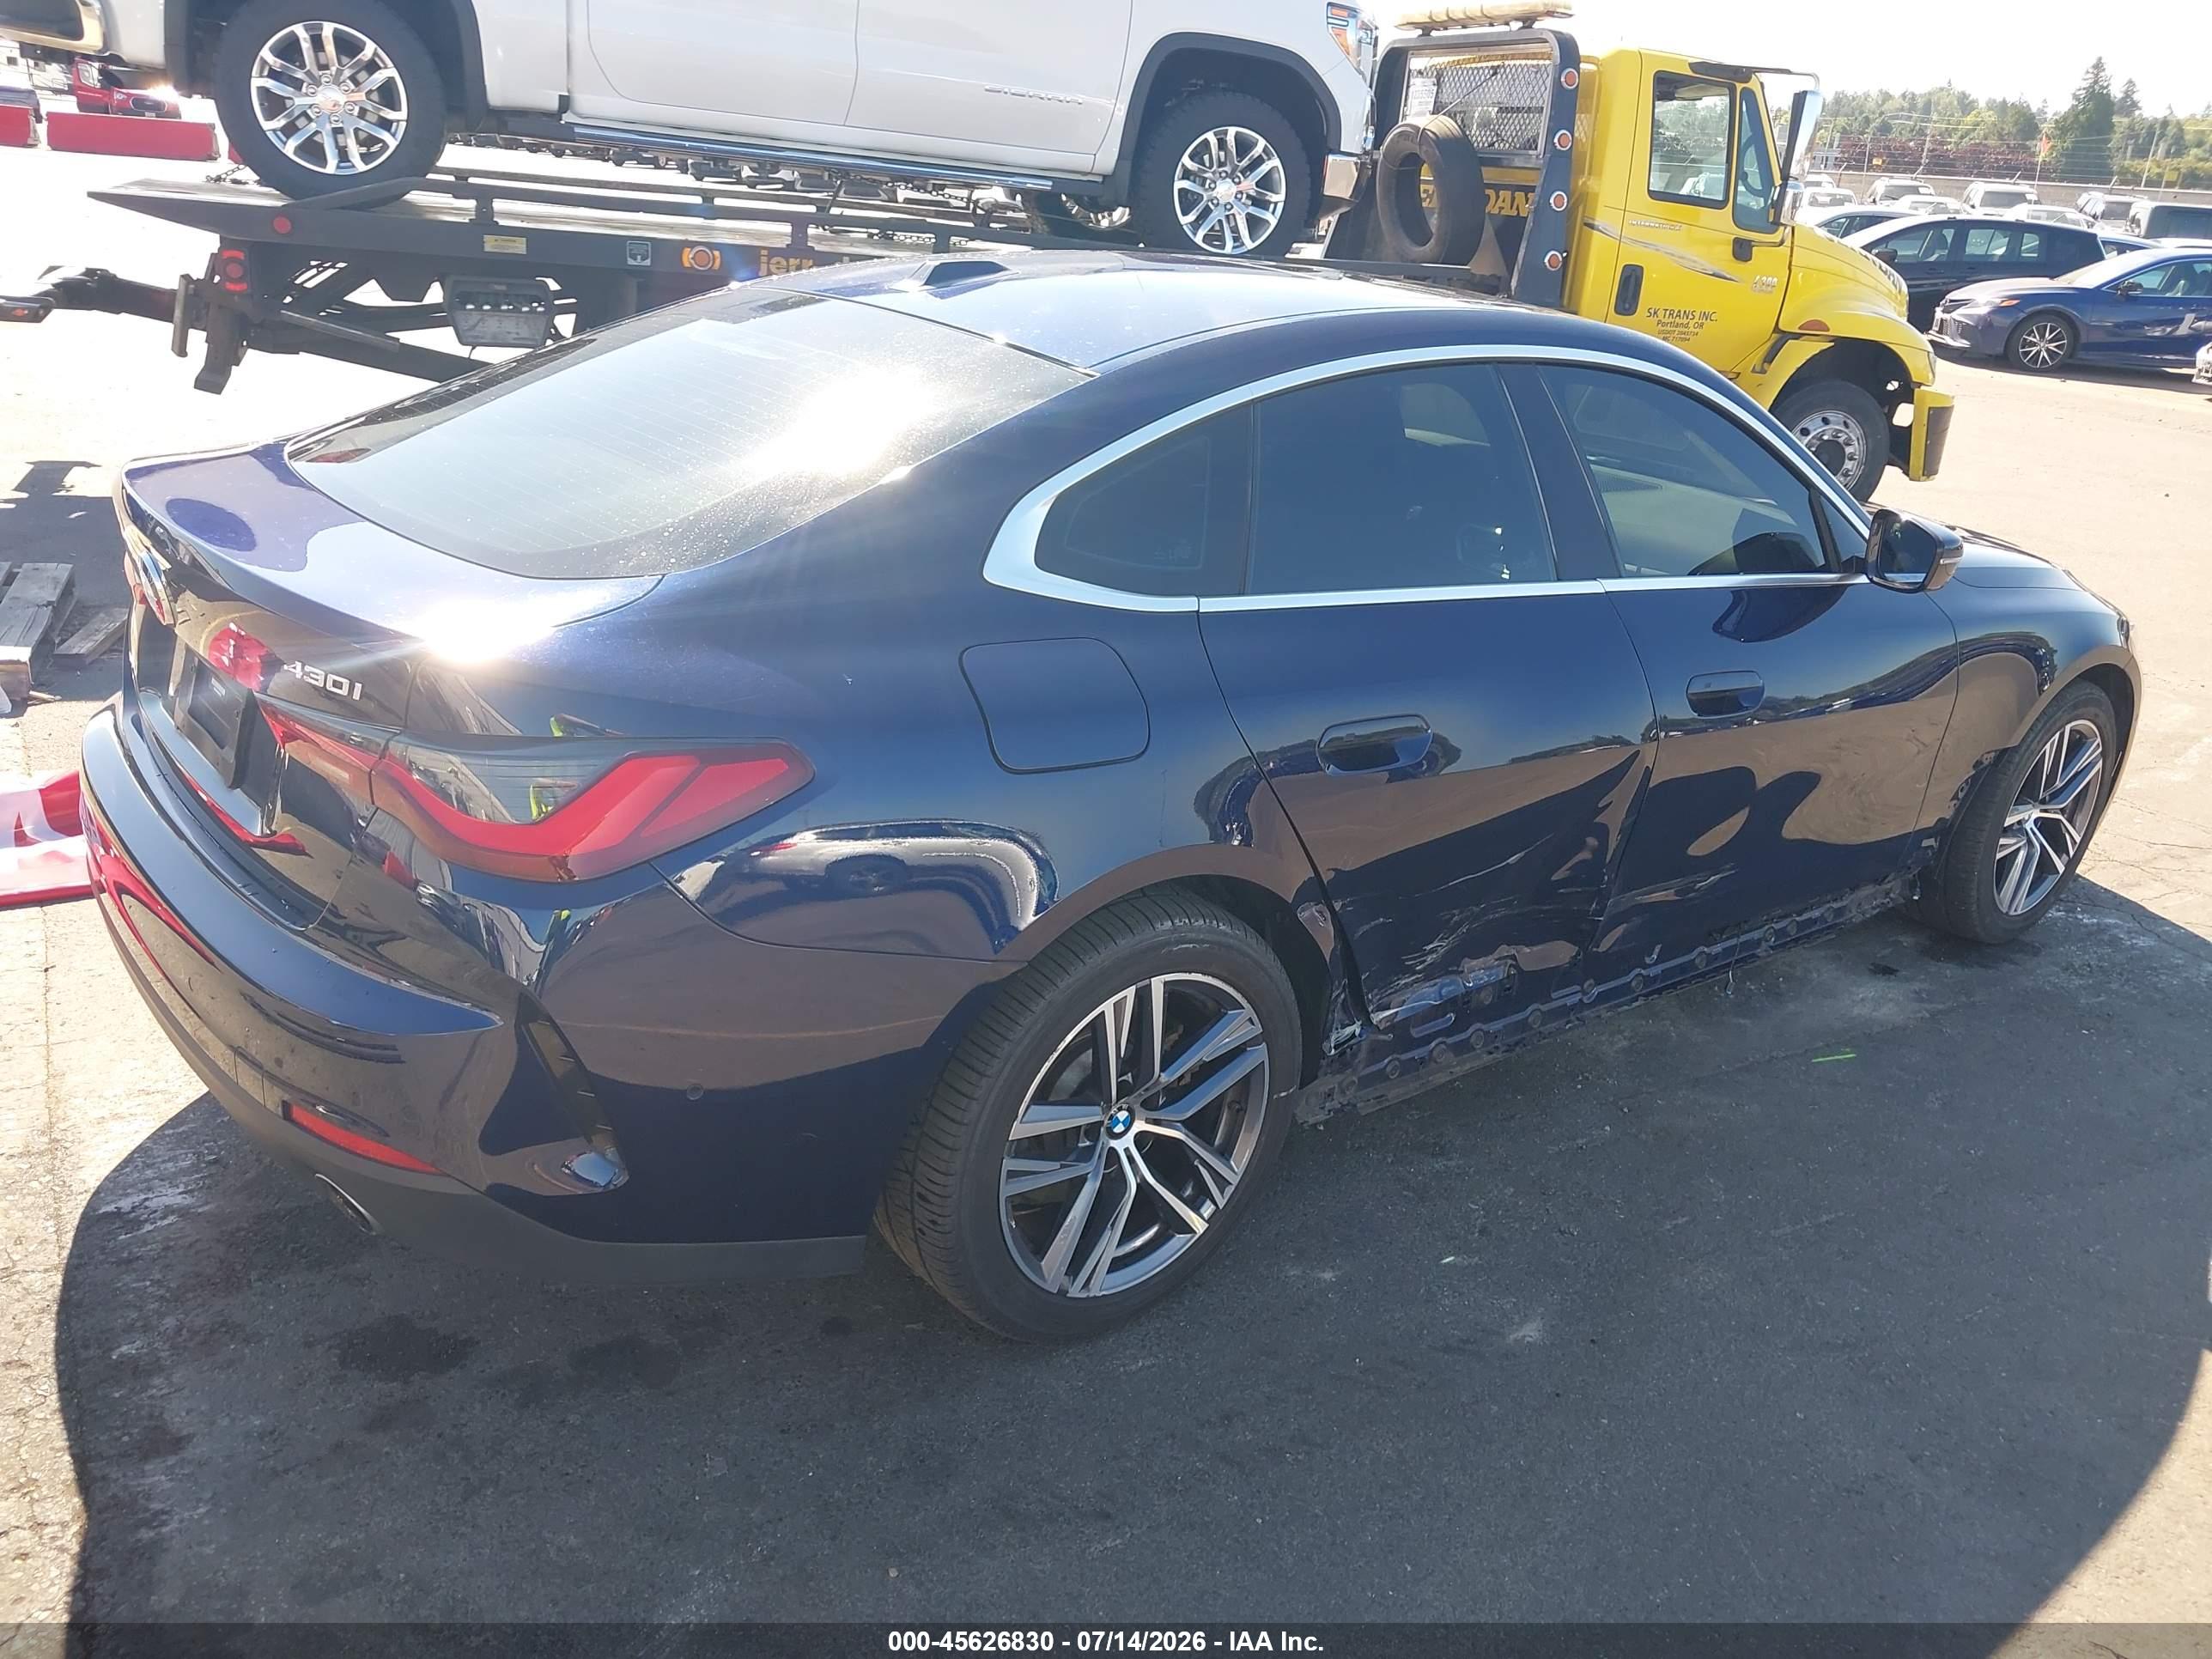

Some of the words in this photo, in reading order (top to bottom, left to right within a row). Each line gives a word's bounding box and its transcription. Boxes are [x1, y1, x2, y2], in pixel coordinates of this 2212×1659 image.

[1646, 307, 1661, 319] SK
[1662, 308, 1696, 320] TRANS
[1698, 310, 1717, 322] INC.
[1656, 319, 1691, 330] Portland,
[1692, 321, 1705, 330] OR
